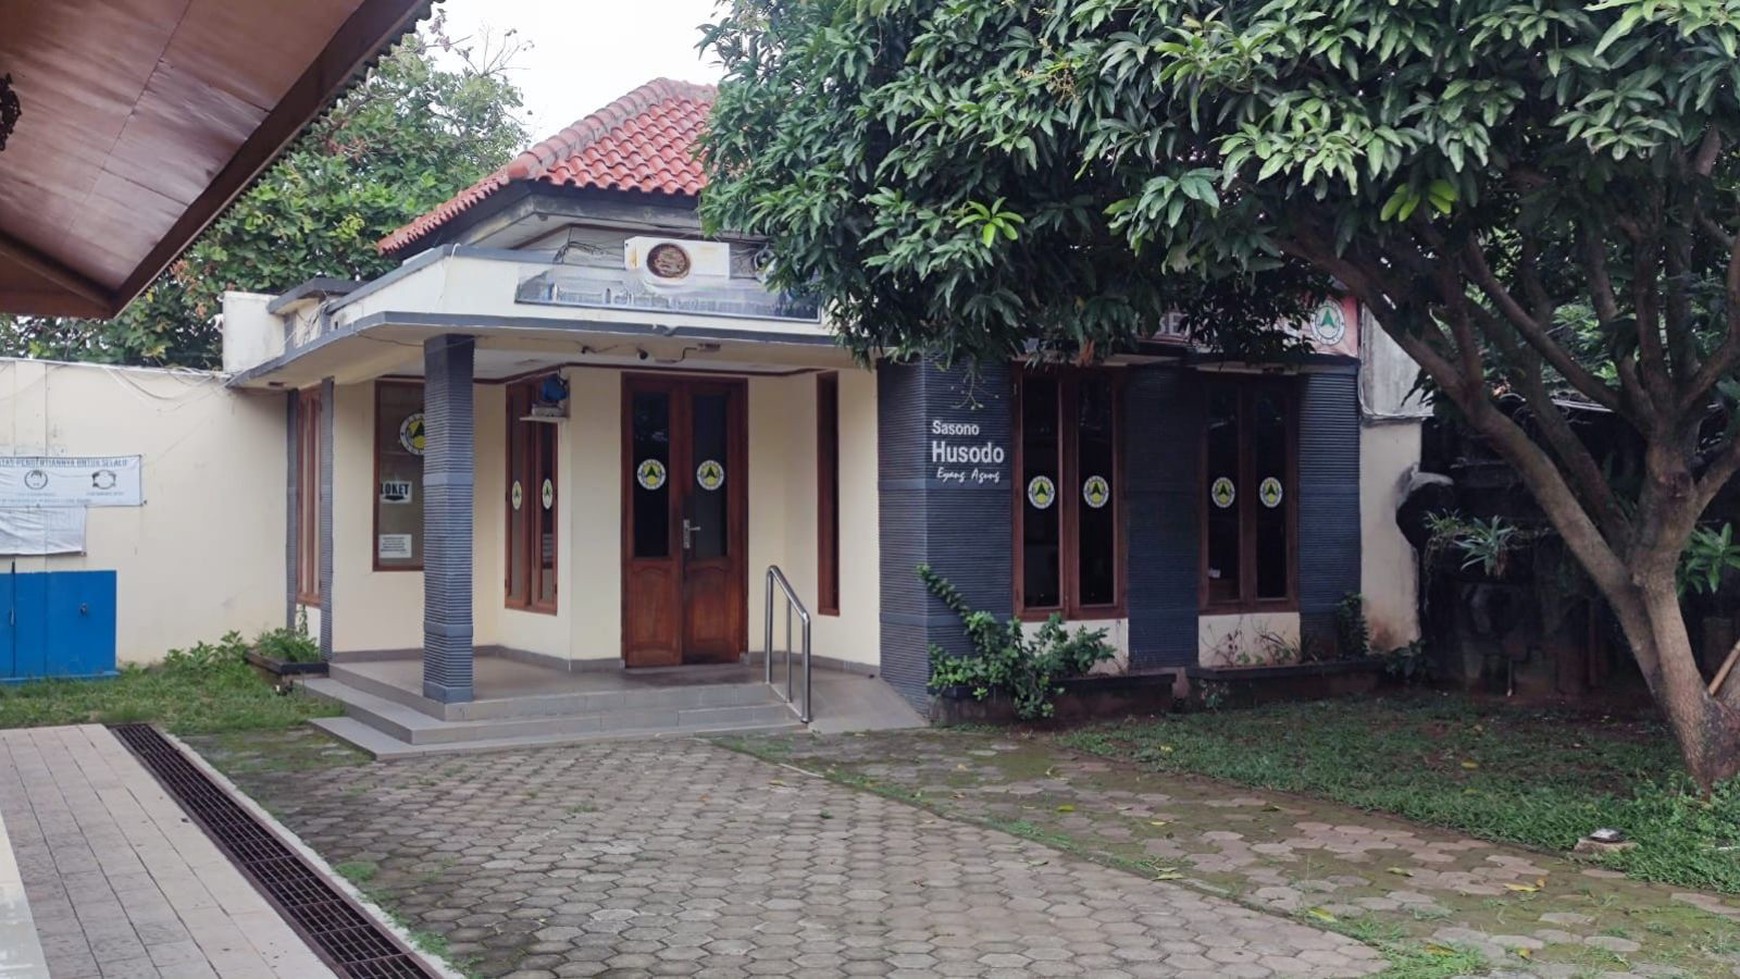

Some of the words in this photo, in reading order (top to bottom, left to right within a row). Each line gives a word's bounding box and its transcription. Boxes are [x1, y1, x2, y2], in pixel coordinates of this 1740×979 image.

[932, 420, 980, 436] Sasono
[932, 441, 1005, 464] Husodo
[937, 467, 966, 483] Eyang
[971, 468, 1001, 484] Agung
[380, 483, 409, 496] LOKET
